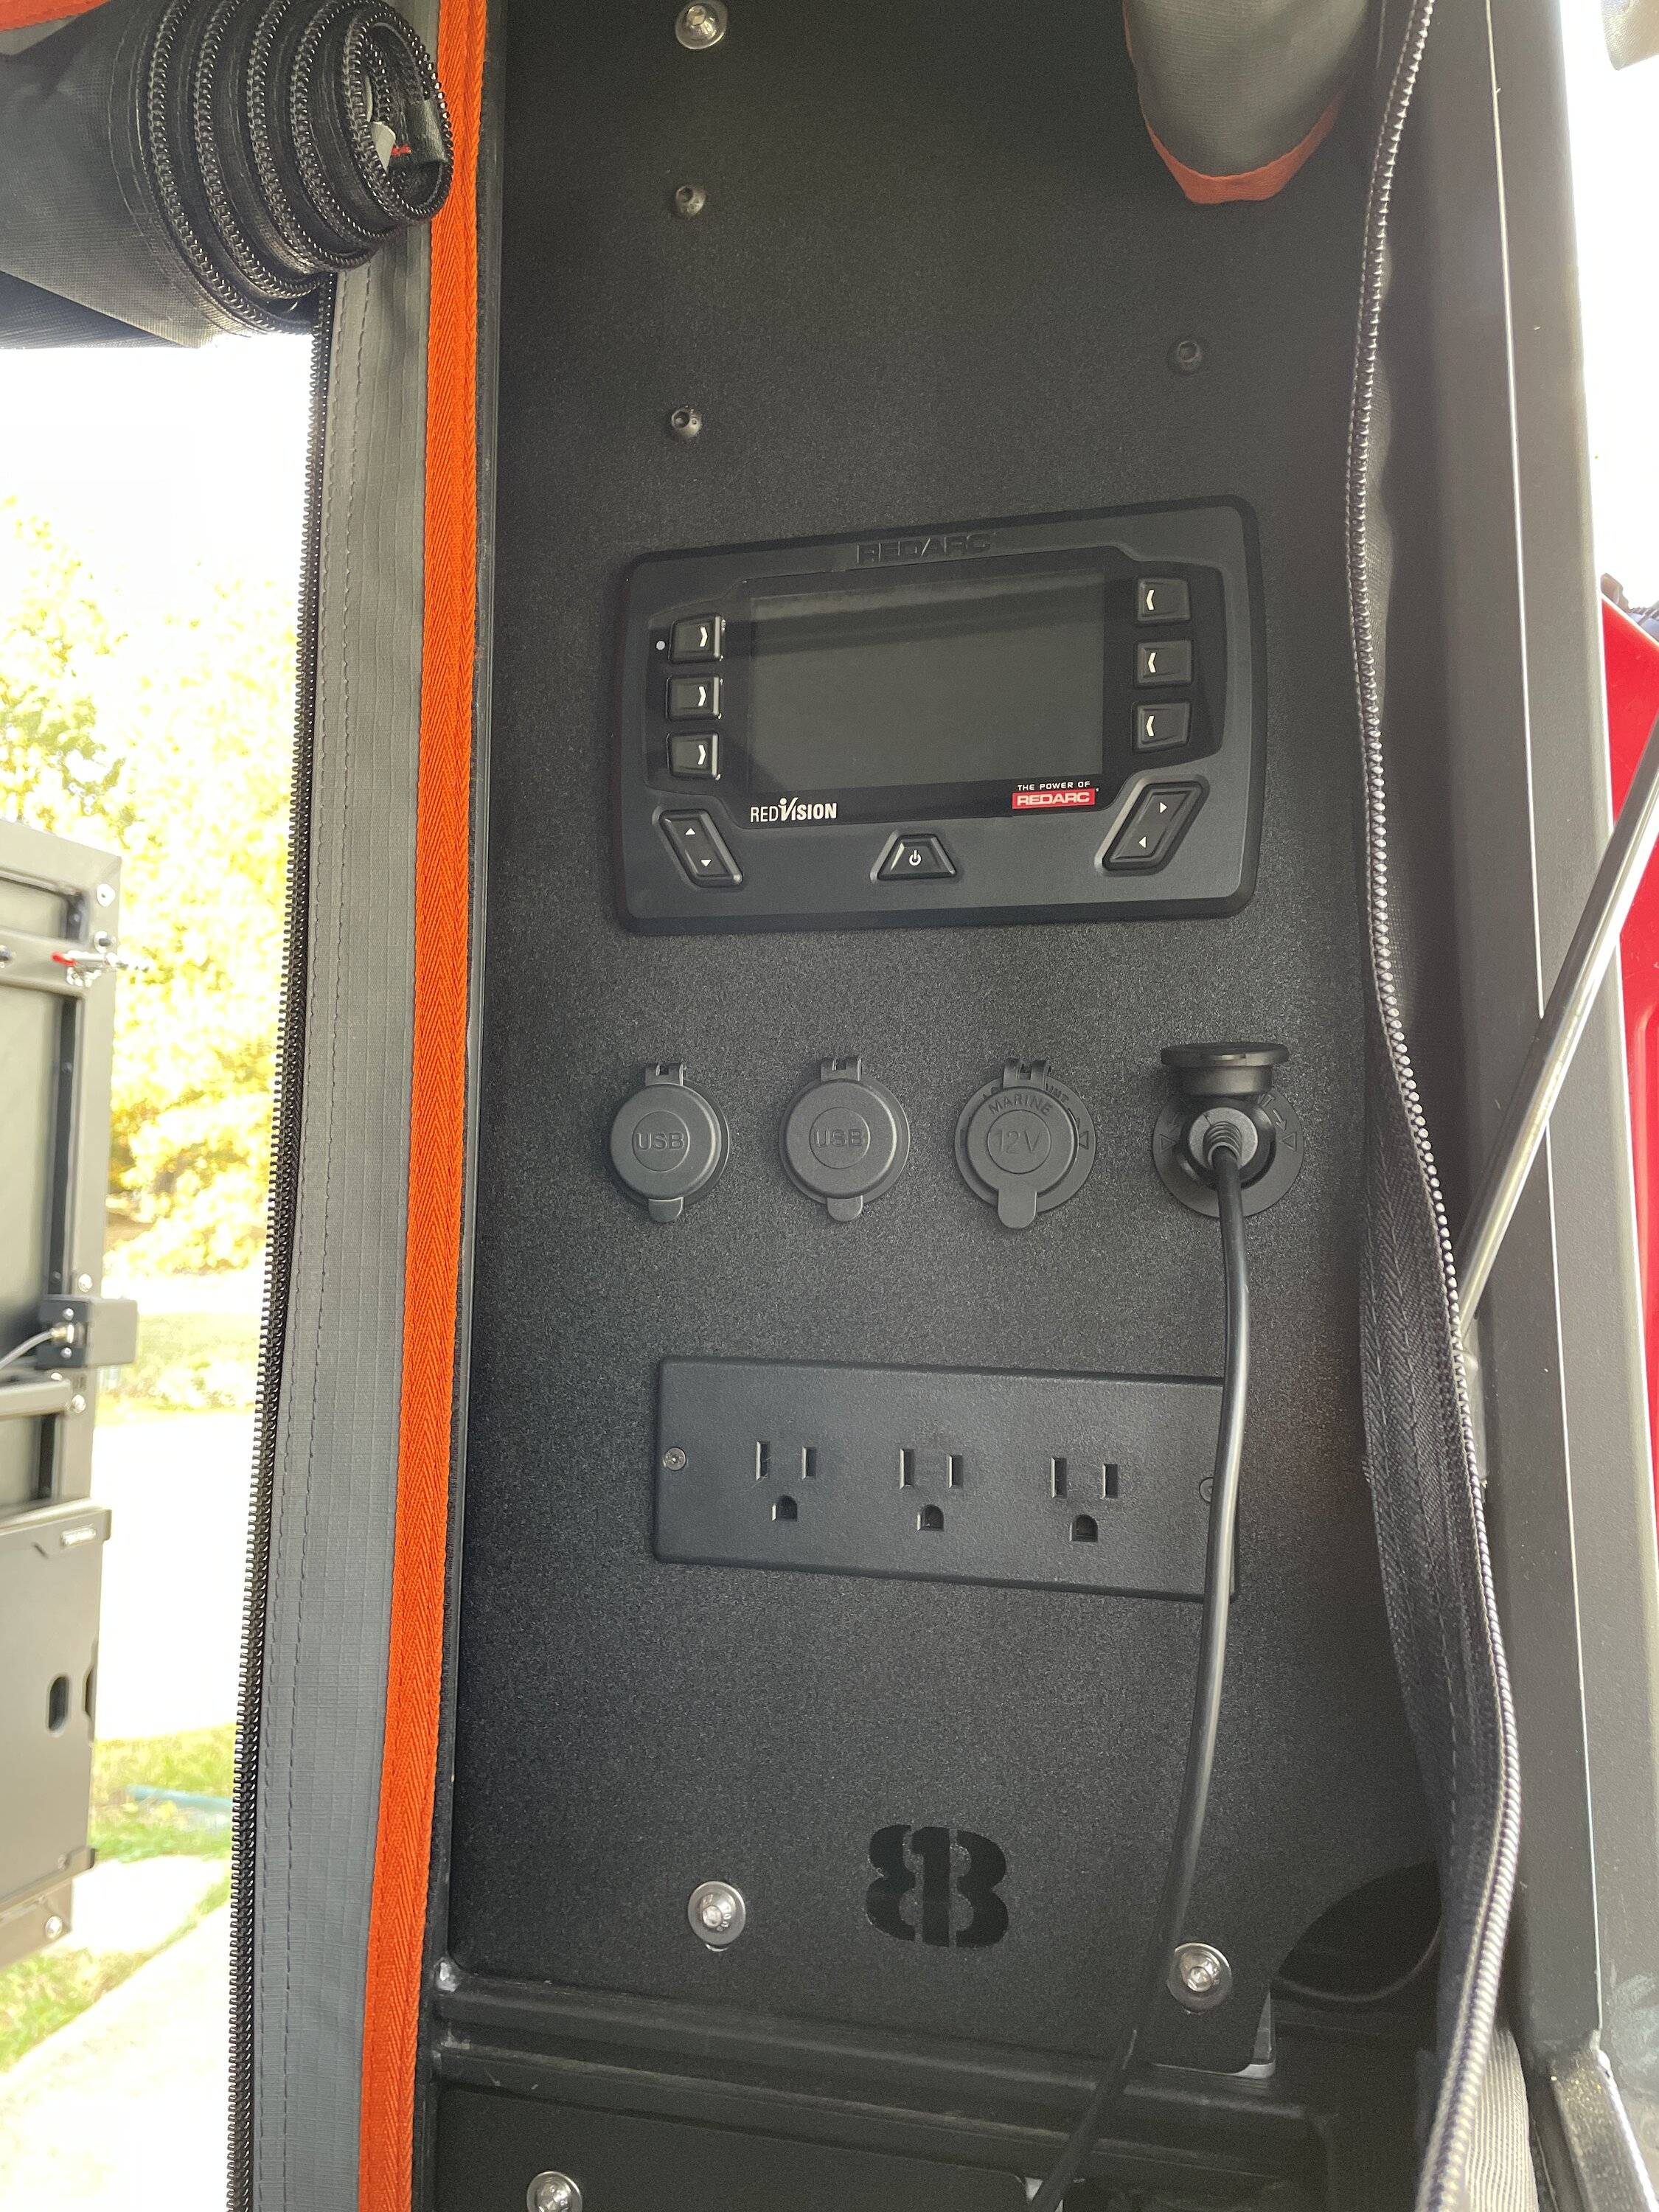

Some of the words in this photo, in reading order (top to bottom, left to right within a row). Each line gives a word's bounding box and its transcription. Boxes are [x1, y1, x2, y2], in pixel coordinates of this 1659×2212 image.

[856, 533, 991, 564] REDARC
[1040, 782, 1074, 790] POWER
[1017, 791, 1090, 806] REDARC
[989, 1093, 1053, 1115] MARINE
[636, 1132, 686, 1151] USB
[814, 1128, 865, 1148] USB
[995, 1128, 1043, 1154] 12V
